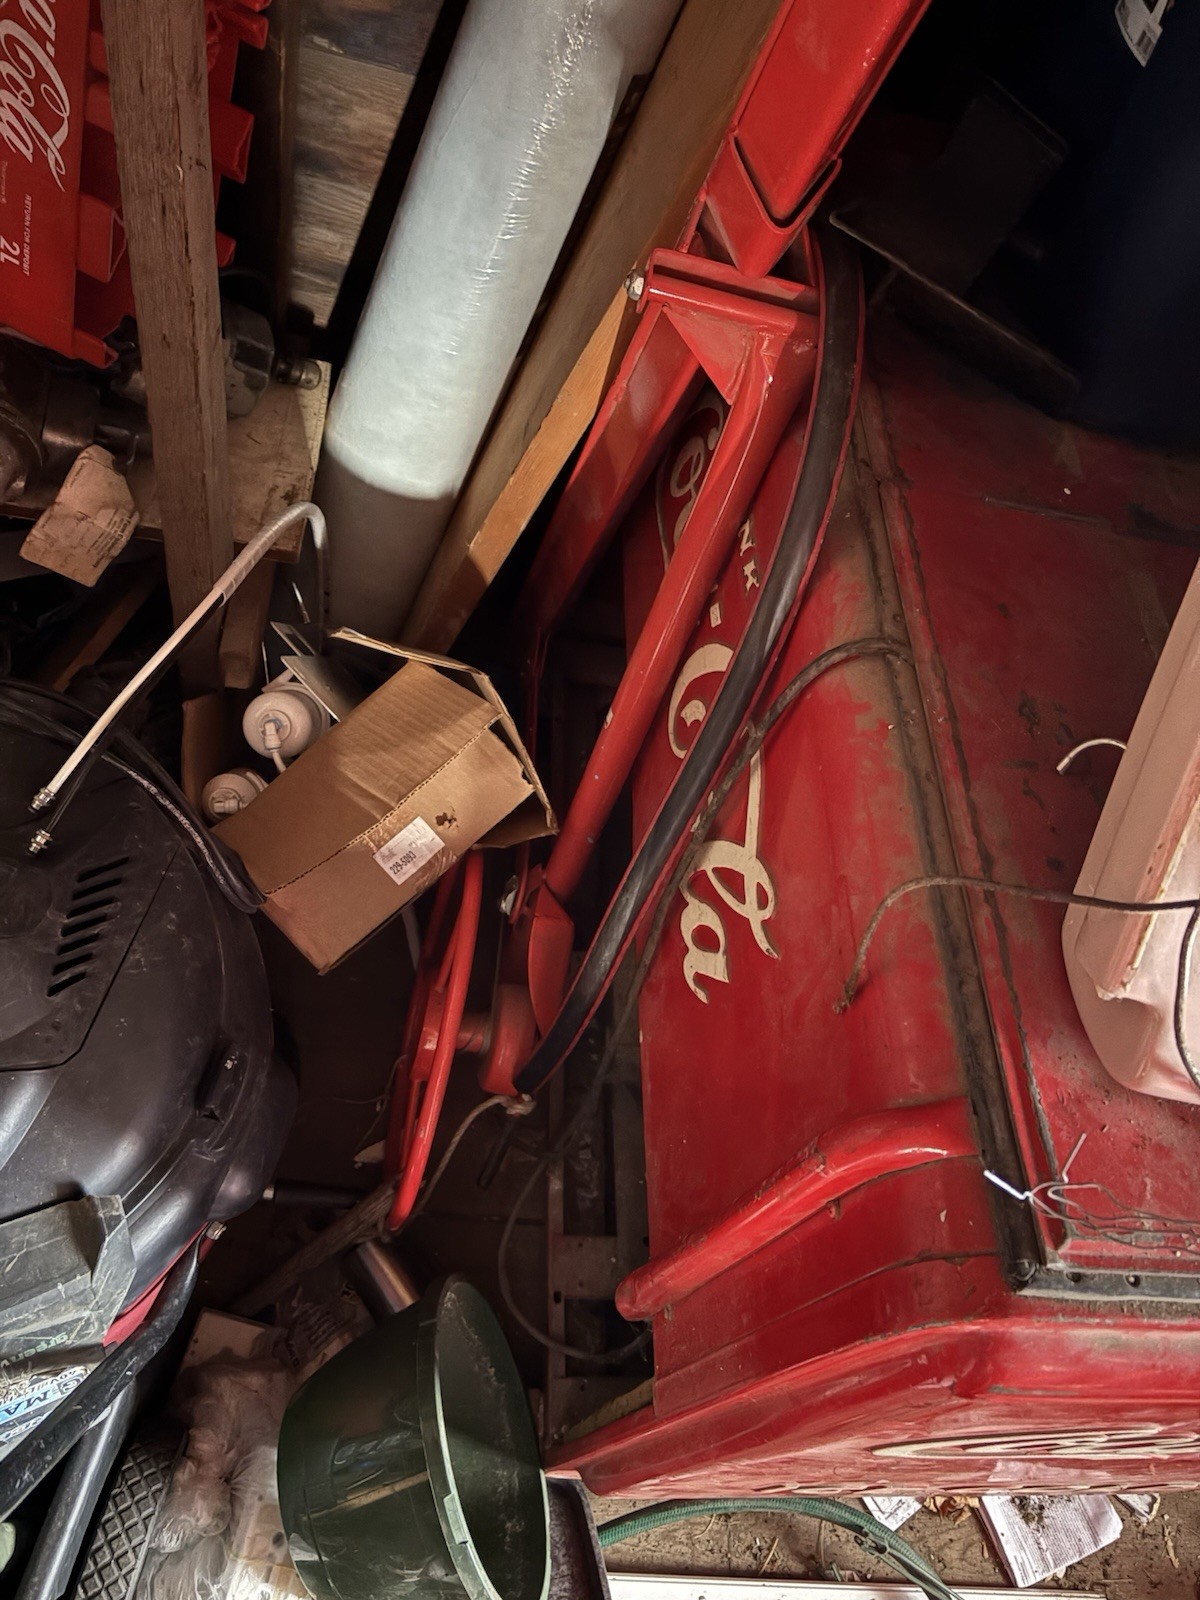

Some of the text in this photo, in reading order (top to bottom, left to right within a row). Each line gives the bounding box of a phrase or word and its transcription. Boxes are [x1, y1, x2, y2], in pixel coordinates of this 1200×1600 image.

[0, 0, 70, 193] a-Cola
[22, 193, 33, 277] RETURN FOR DEPOSIT
[389, 850, 417, 875] 229-5093
